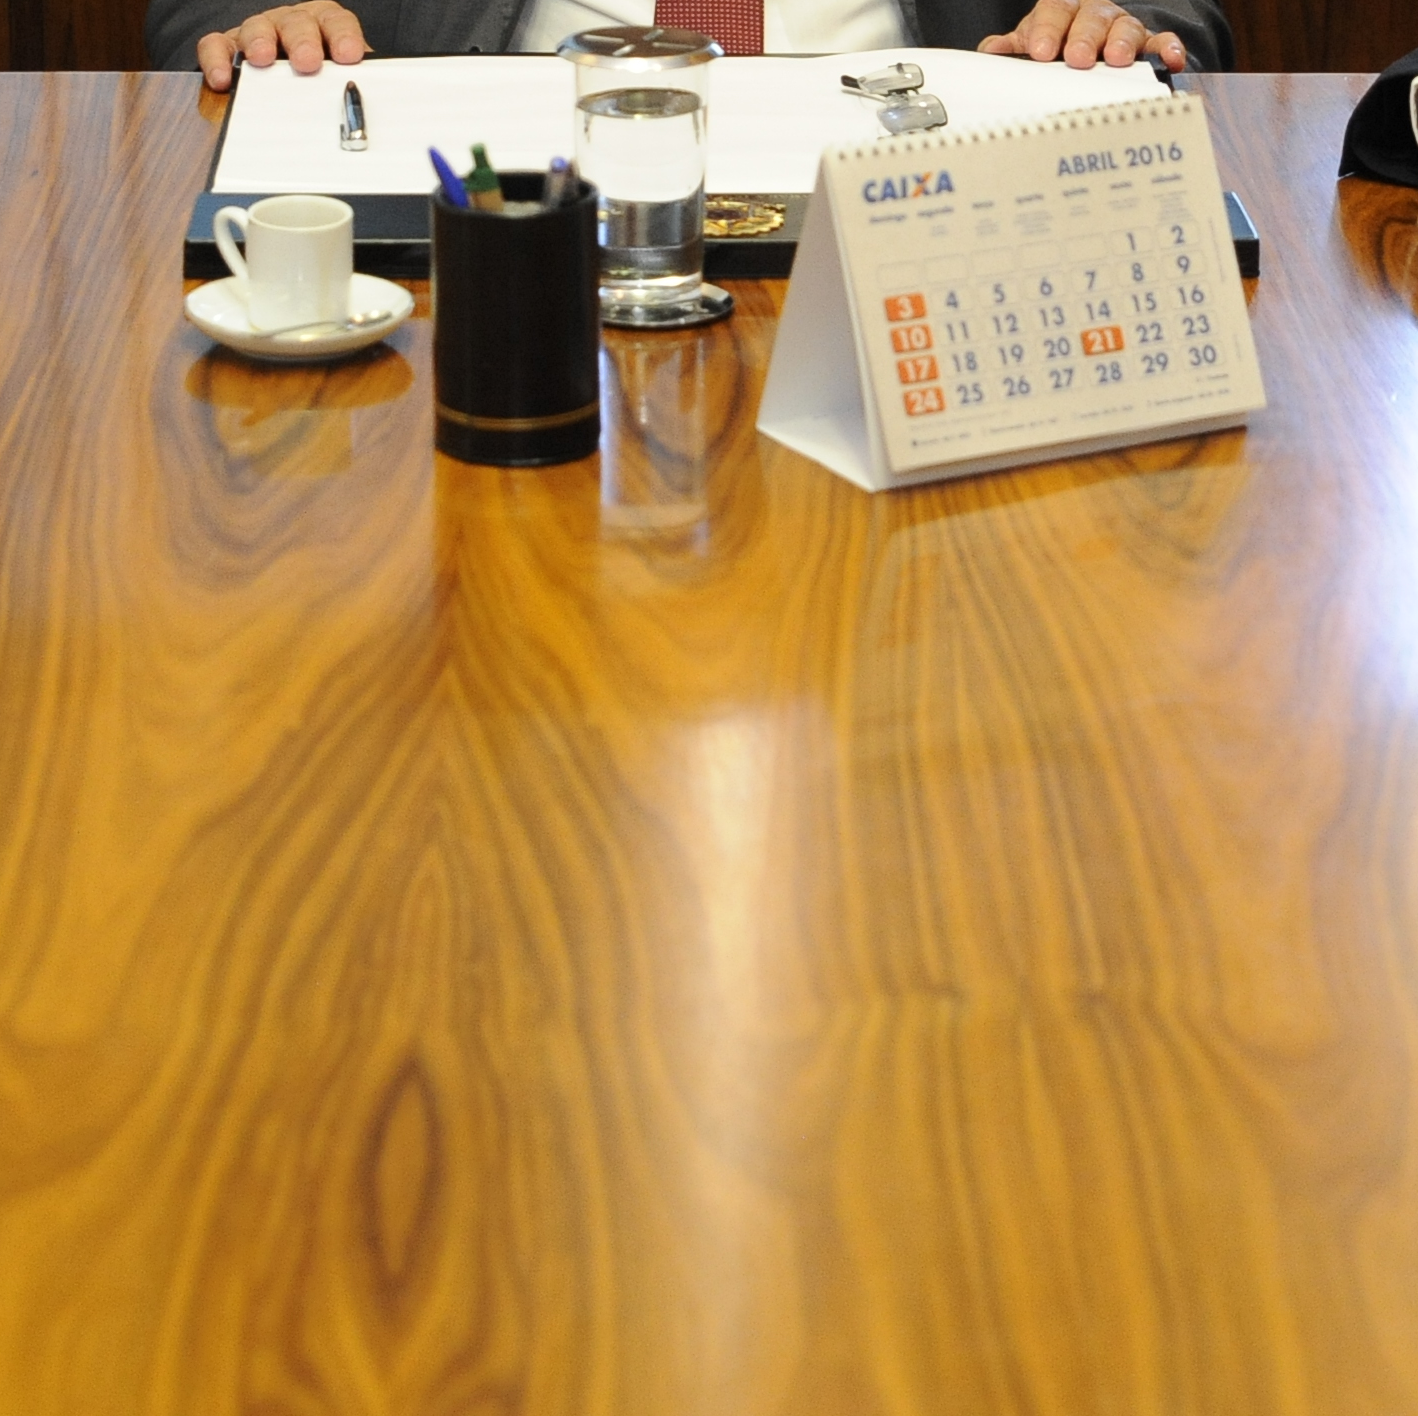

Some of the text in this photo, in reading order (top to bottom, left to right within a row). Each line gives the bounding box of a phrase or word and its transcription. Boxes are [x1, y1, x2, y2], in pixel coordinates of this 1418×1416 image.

[861, 169, 956, 205] CAIXA
[1056, 141, 1184, 177] ABRIL 2016
[1126, 224, 1186, 251] 1 2
[897, 254, 1191, 320] 3 4 5 6 7 8 9
[900, 284, 1205, 352] 10 11 12 13 14 15 16
[905, 313, 1211, 382] 17 18 19 20 21 22 23
[910, 343, 1217, 414] 24 25 26 27 28 29 30
